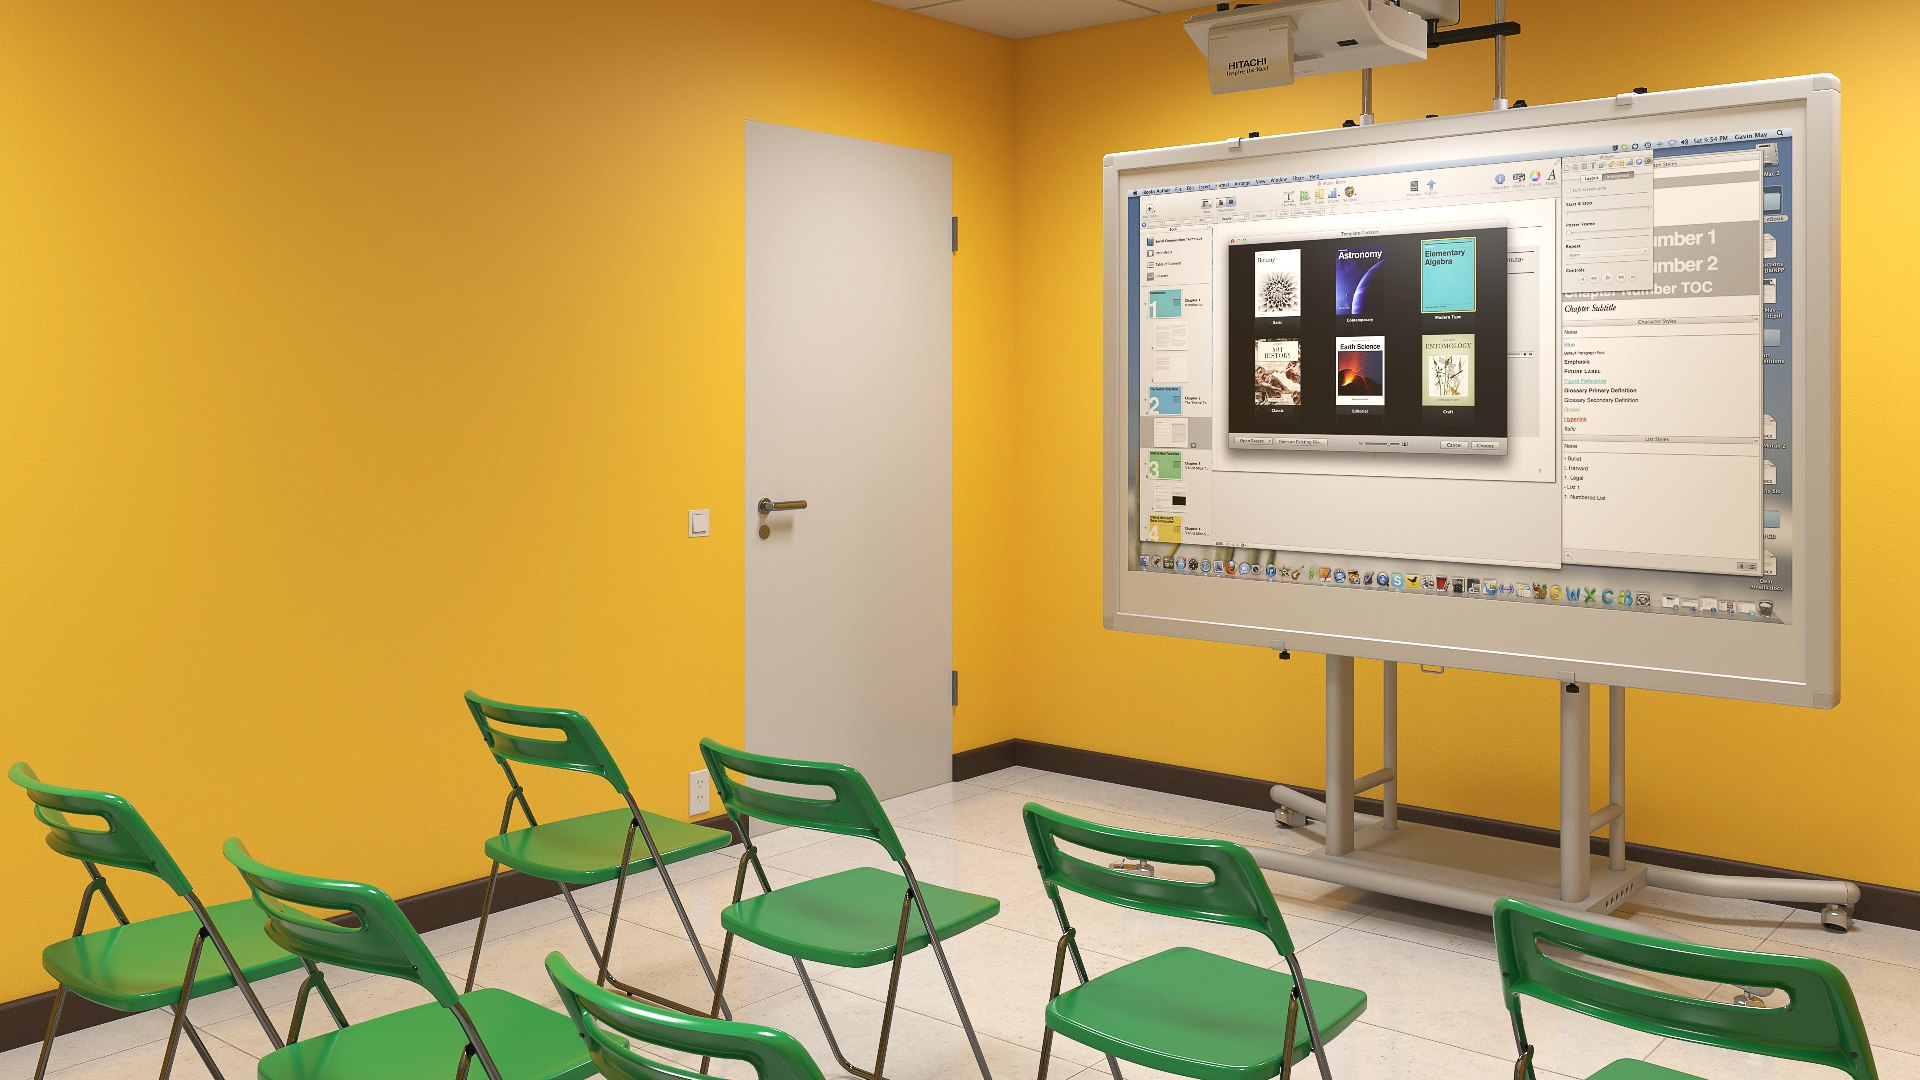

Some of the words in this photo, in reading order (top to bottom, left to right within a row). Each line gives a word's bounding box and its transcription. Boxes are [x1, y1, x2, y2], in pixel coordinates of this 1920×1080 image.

[1228, 57, 1267, 70] HITACHI
[1226, 68, 1245, 77] Inspire
[1735, 133, 1754, 142] Gavin
[1755, 131, 1769, 140] May
[1662, 159, 1678, 168] Styles
[1708, 228, 1717, 245] 1
[1338, 249, 1383, 261] Astronomy
[1424, 249, 1466, 259] Elementary
[1424, 257, 1453, 267] Algebra
[1706, 255, 1719, 271] 2
[1681, 280, 1713, 294] TOC
[1150, 300, 1157, 319] 1
[1564, 304, 1590, 314] Chapter
[1592, 303, 1617, 312] Subtitle
[1149, 397, 1160, 416] 2
[1149, 460, 1160, 479] 3
[1149, 525, 1160, 542] 4
